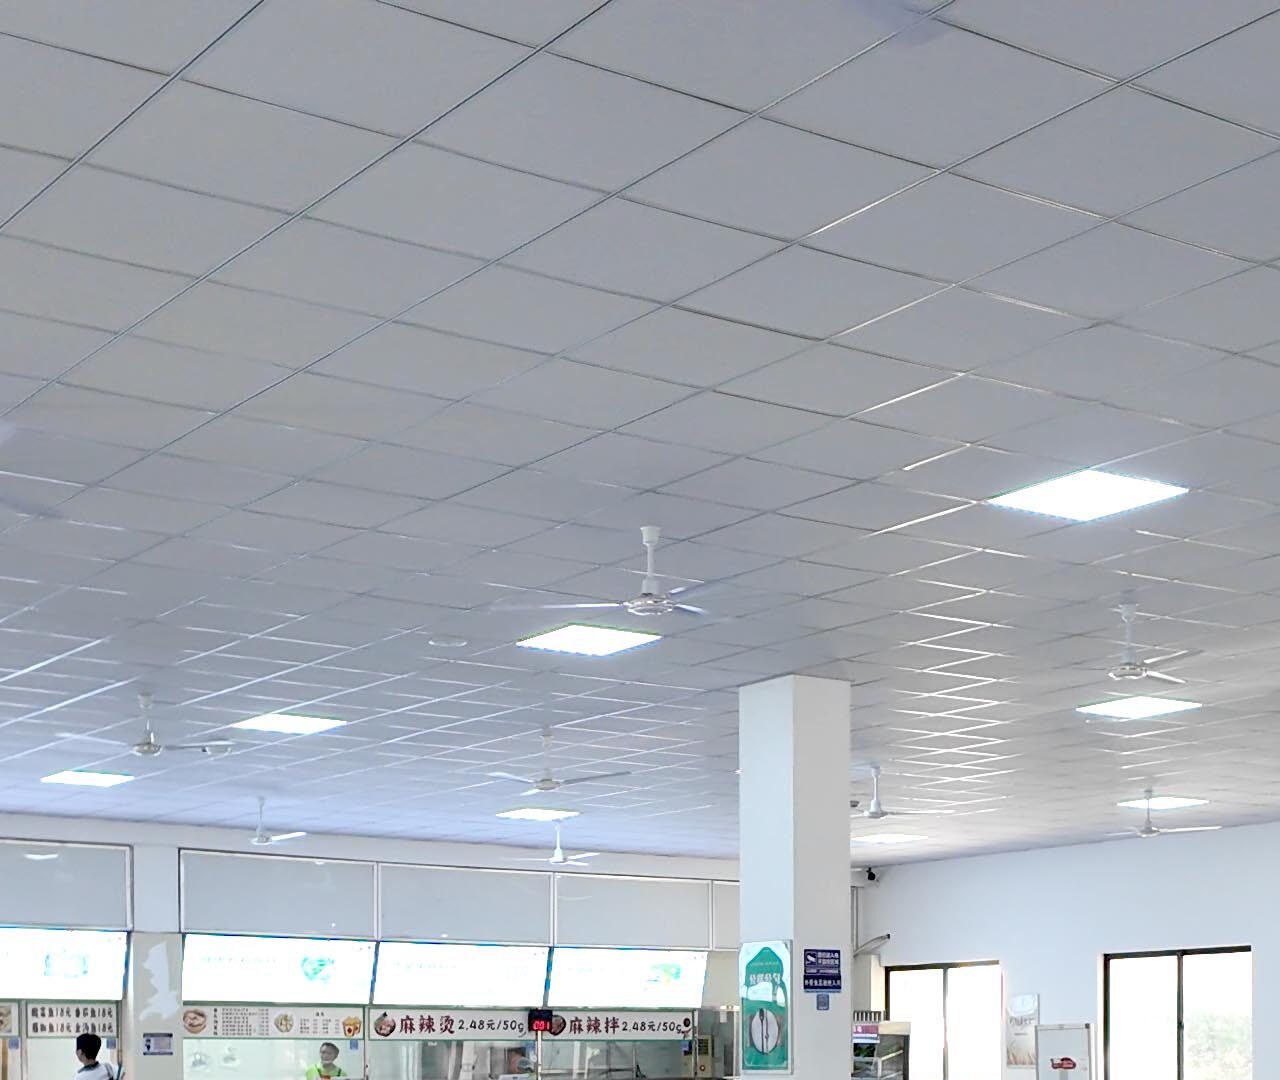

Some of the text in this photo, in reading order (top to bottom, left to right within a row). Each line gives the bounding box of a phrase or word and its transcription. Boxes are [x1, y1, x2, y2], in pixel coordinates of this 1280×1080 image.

[399, 1014, 455, 1034] 麻辣烫
[570, 1016, 620, 1034] 麻辣拌
